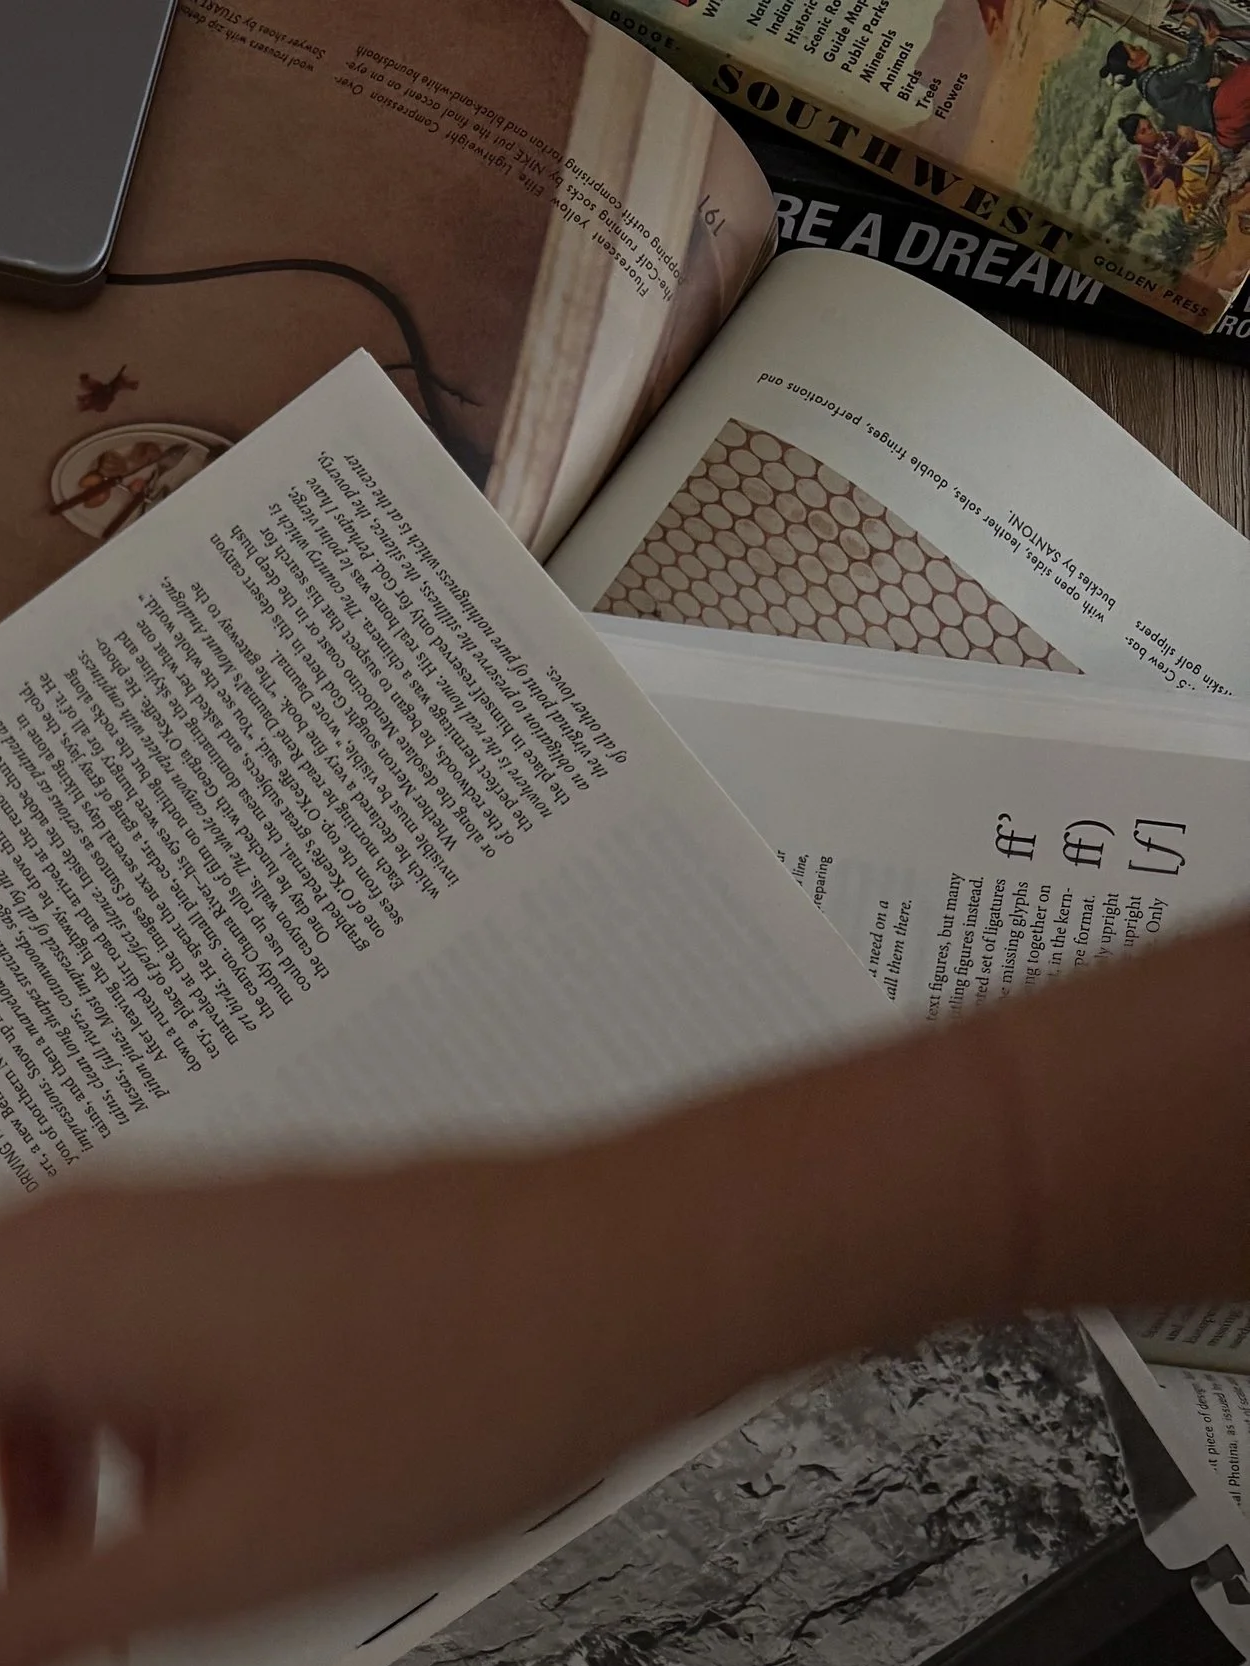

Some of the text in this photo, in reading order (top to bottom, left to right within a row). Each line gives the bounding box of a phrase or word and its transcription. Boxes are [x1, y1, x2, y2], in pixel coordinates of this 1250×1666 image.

[803, 16, 832, 55] Scenic
[822, 26, 850, 63] Guide
[840, 0, 889, 73] Public Parks
[859, 29, 897, 83] Minerals
[879, 41, 914, 93] Animals
[896, 69, 922, 102] Birds
[369, 91, 440, 133] Compression
[914, 77, 942, 109] Trees
[934, 72, 968, 120] Flowers
[444, 130, 513, 176] Lightweight
[711, 63, 1077, 254] SOUTHWEST
[517, 170, 545, 197] Elite
[553, 198, 591, 229] yellow
[839, 212, 882, 258] A
[591, 231, 649, 297] Fluorescent
[1093, 250, 1164, 292] GOLDEN
[1162, 285, 1209, 318] PRESS
[756, 372, 1104, 623] with open sides, leather soles, double fringes, perforations and
[1007, 510, 1116, 611] buckles by SANTONI.
[95, 637, 131, 677] photo-
[1124, 636, 1176, 682] Crew bas-
[124, 676, 142, 698] He
[180, 748, 218, 797] Georgia
[215, 795, 240, 826] with
[234, 824, 280, 878] lunched
[276, 874, 292, 895] he
[288, 892, 310, 915] day
[307, 915, 330, 943] One
[927, 872, 966, 991] figures, but many
[1001, 881, 1030, 983] missing glyphs
